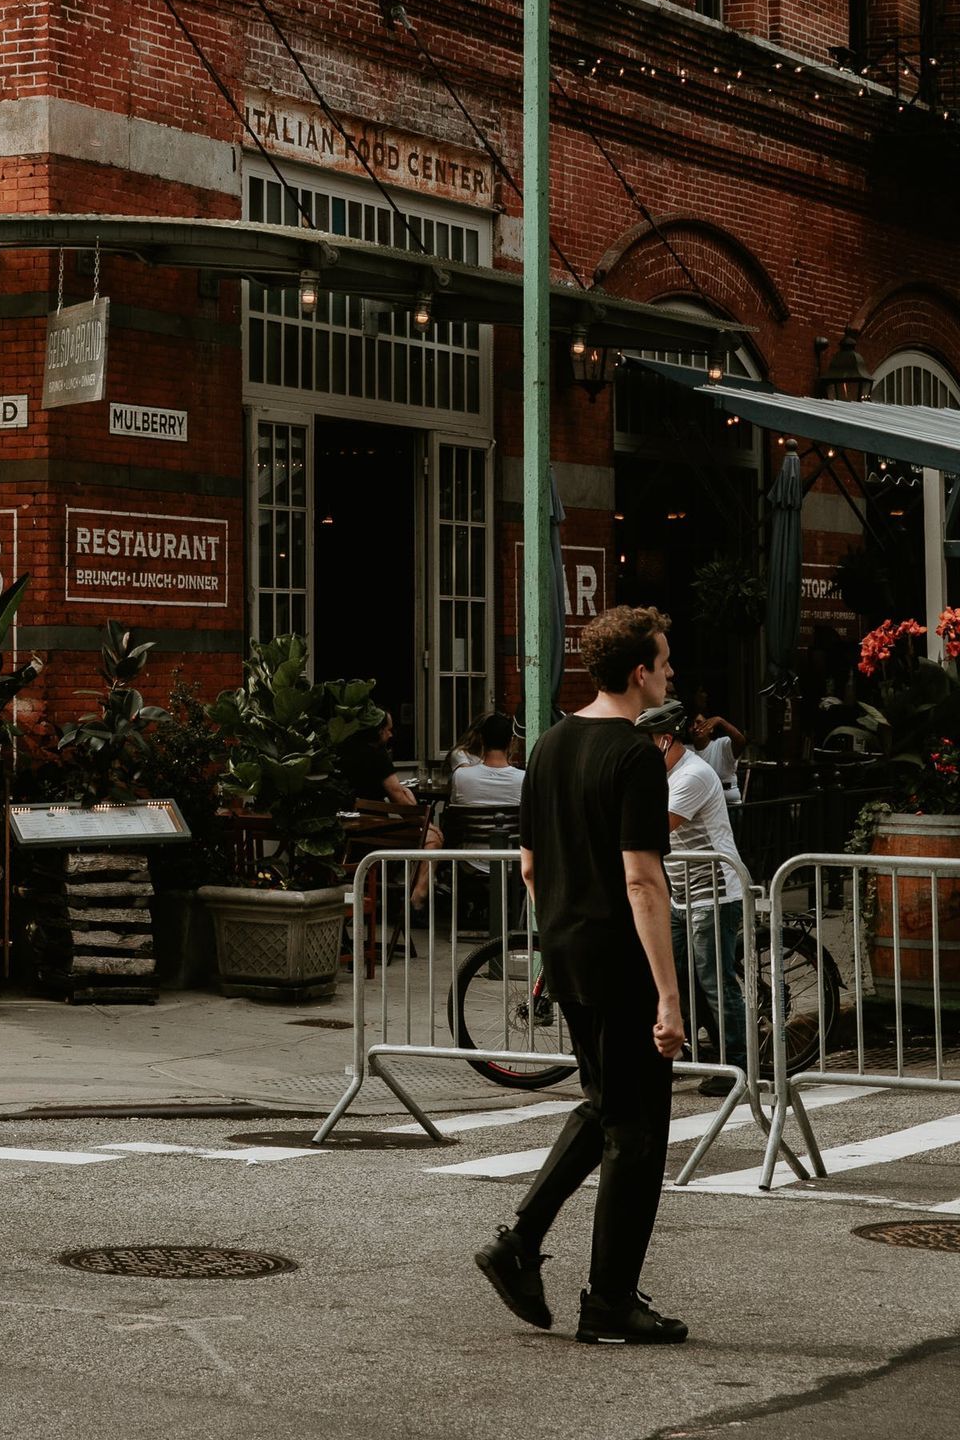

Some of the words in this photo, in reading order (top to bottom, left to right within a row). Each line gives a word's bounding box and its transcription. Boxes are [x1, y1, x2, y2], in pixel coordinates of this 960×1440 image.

[245, 107, 334, 155] ITALIAN
[344, 134, 400, 170] FOOD
[407, 152, 484, 194] CENTER
[113, 408, 185, 436] MULBERRY
[76, 527, 220, 561] RESTAURANT
[76, 569, 126, 586] BRUNCH
[132, 572, 172, 588] LUNCH
[177, 574, 219, 590] DINNER
